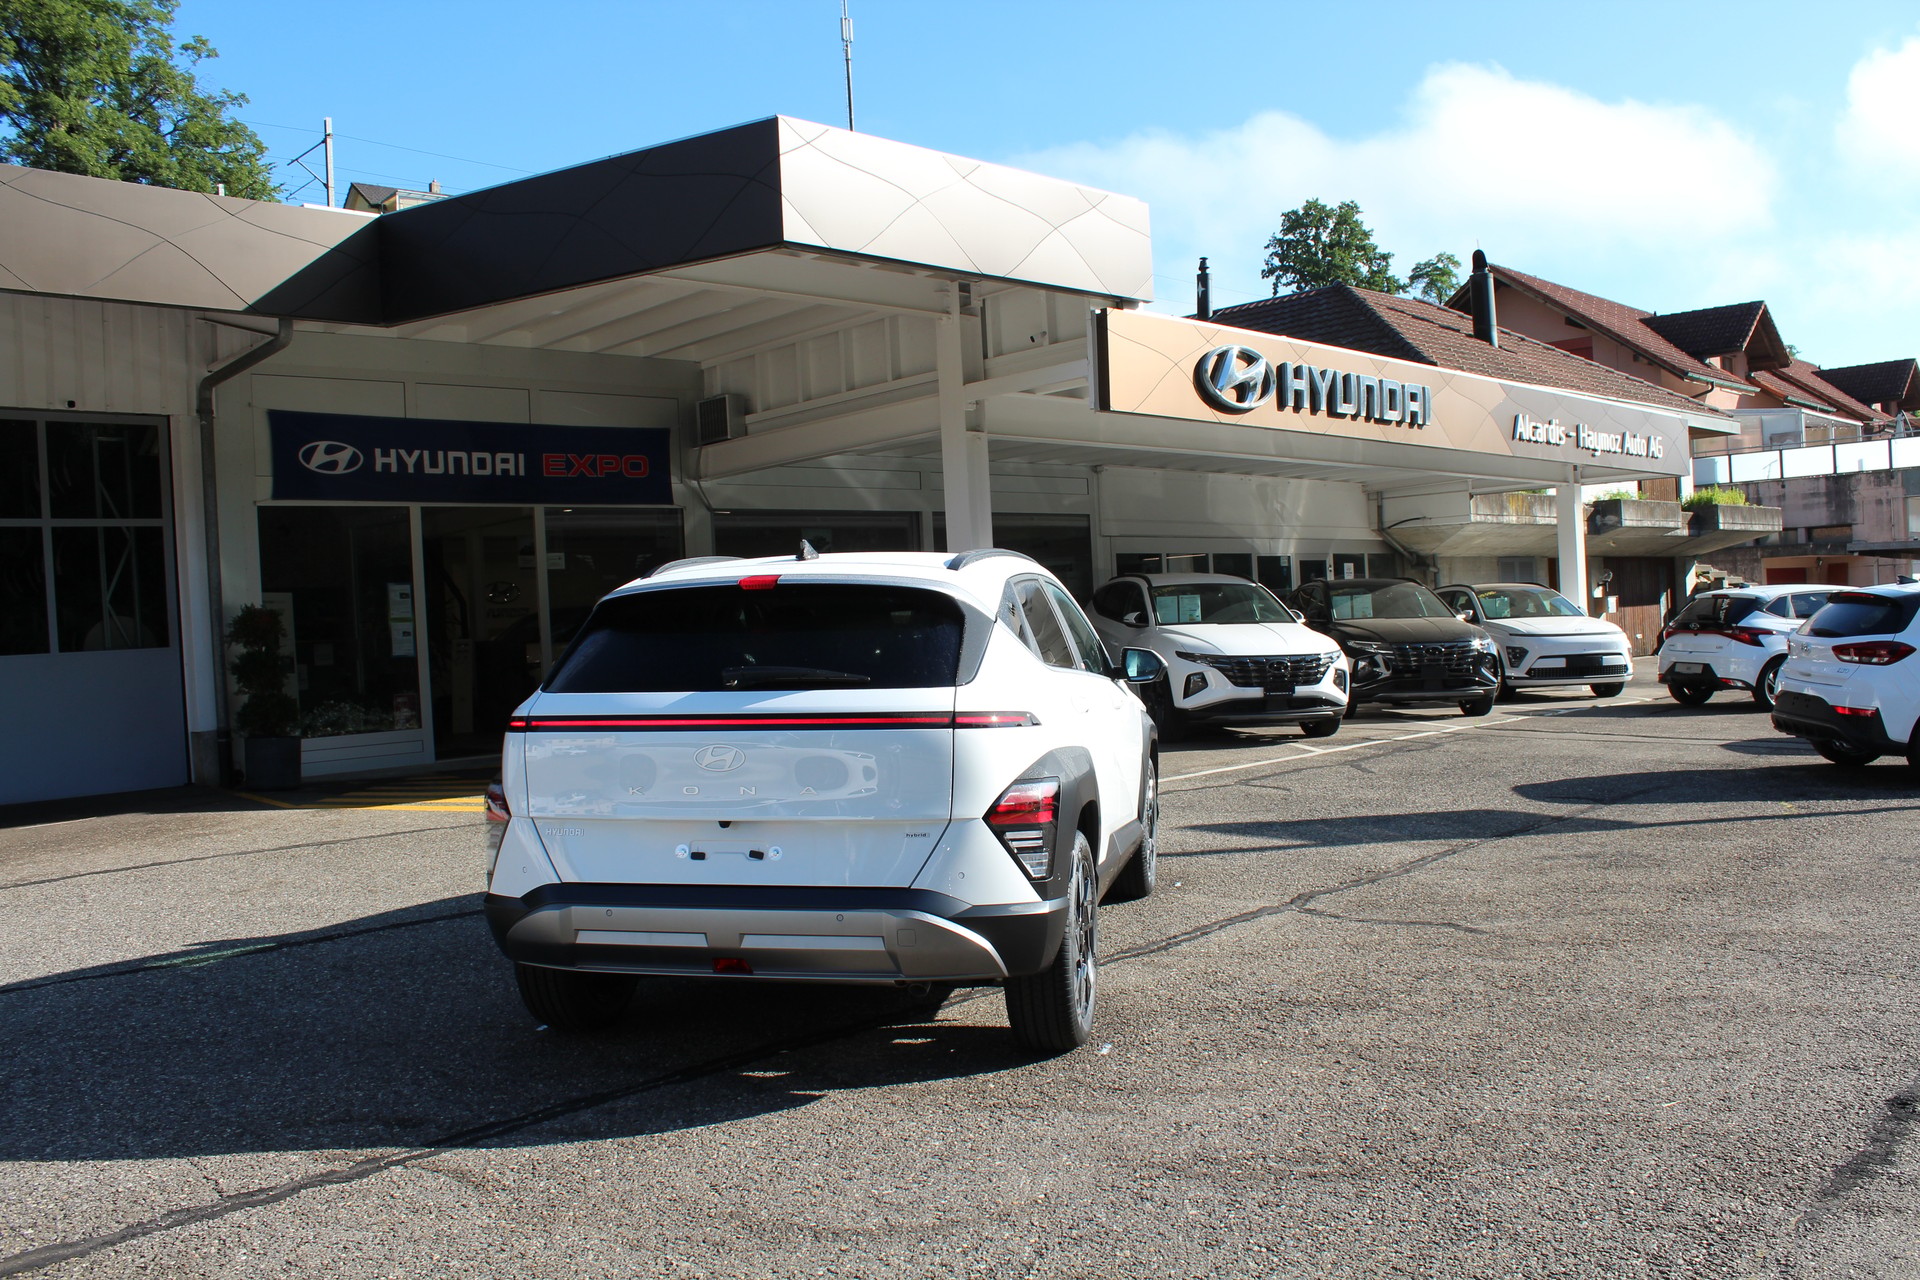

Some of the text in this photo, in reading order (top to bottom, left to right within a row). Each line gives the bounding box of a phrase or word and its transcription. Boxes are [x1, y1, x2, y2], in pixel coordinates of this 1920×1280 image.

[1277, 361, 1432, 428] HYUNDAI
[1514, 413, 1566, 446] Alcardis
[1577, 423, 1622, 457] Haymoz
[1623, 431, 1647, 457] Auto
[1648, 435, 1664, 459] AG
[374, 447, 650, 479] HYUNDAI EXPO
[628, 785, 818, 796] KONA
[545, 828, 585, 837] HYUNDAI
